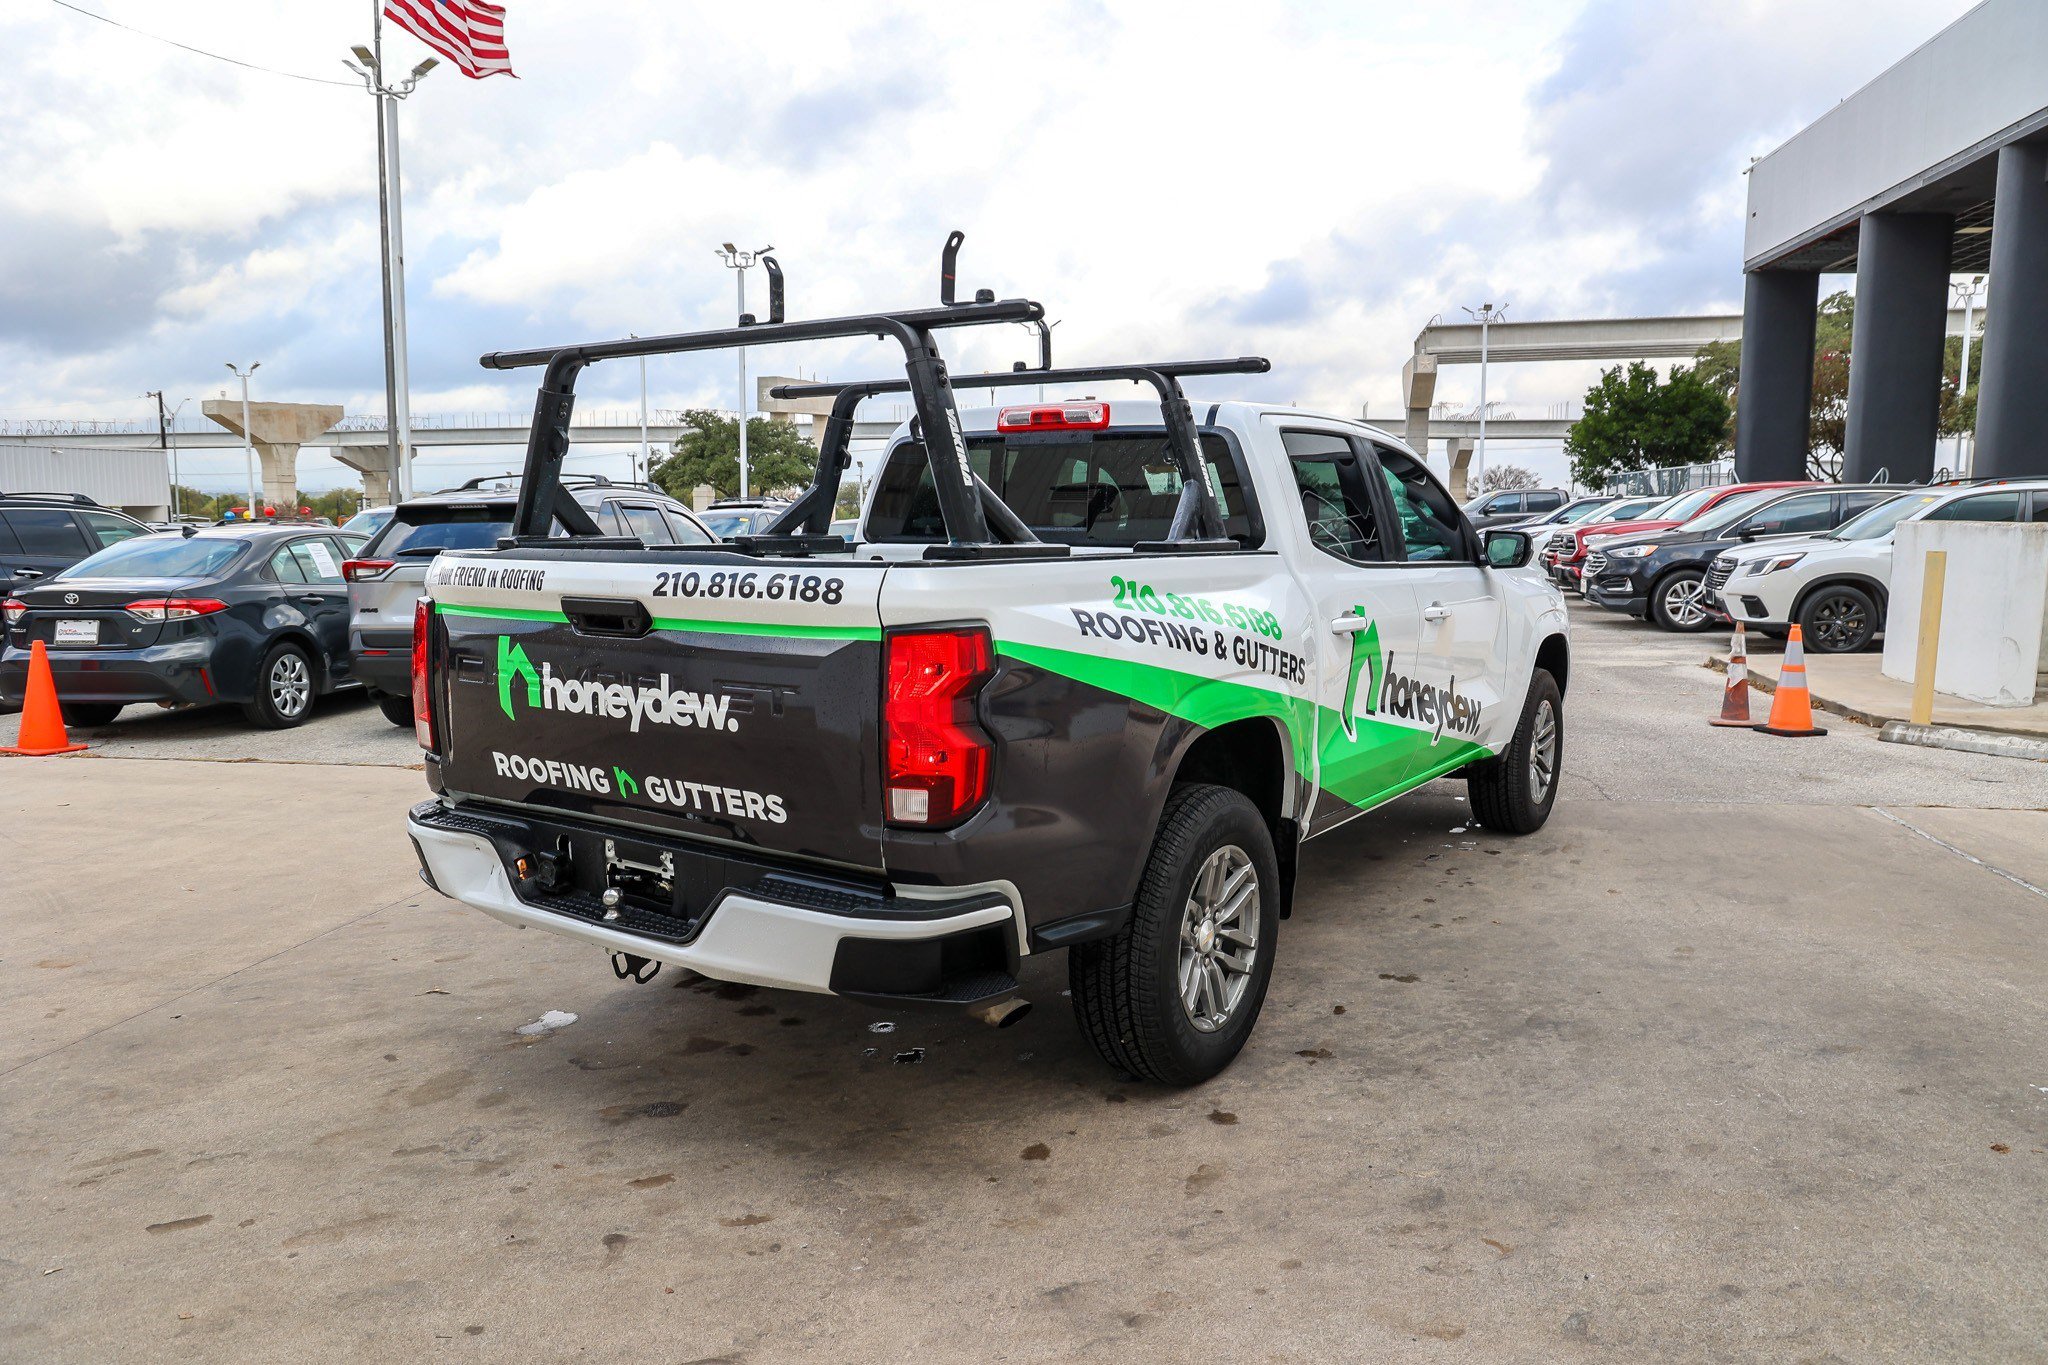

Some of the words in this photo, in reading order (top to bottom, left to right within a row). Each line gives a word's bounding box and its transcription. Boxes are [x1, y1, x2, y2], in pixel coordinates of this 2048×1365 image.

[945, 408, 973, 487] YAKIMA
[1192, 437, 1215, 498] YAKIMA
[453, 566, 487, 588] FRIEND
[487, 570, 499, 588] IN
[500, 568, 546, 592] ROOFING
[652, 571, 845, 605] 210.816.6188
[1110, 575, 1283, 641] 210.816.6188
[1070, 607, 1208, 656] ROOFING
[1214, 630, 1228, 661] &
[1233, 635, 1306, 686] GUTTERS
[542, 661, 740, 733] honeydew.
[492, 751, 611, 794] ROOFING
[644, 775, 788, 824] GUTTERS
